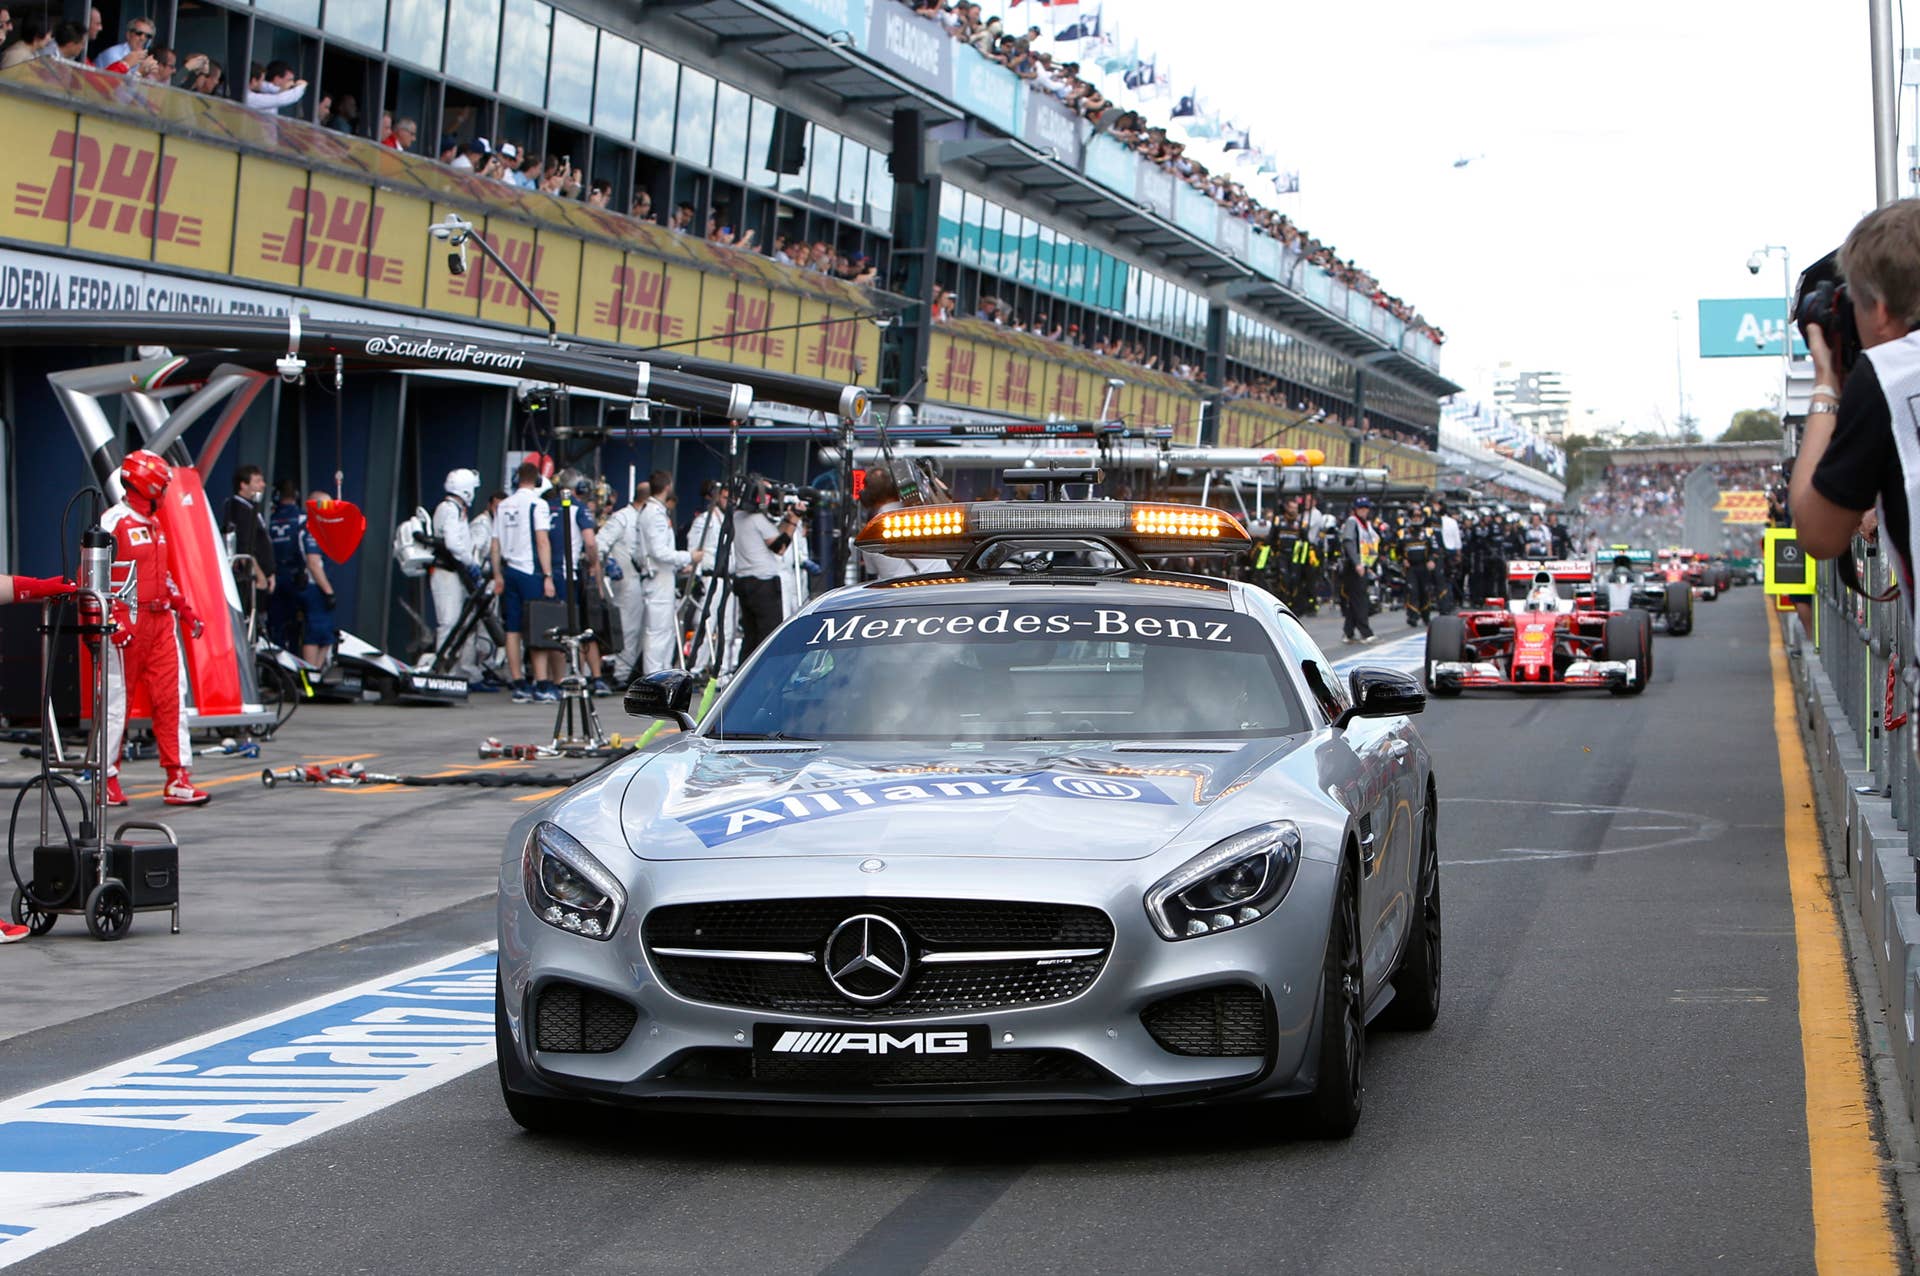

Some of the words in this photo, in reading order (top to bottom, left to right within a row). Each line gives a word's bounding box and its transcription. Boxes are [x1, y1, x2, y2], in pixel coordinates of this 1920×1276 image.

[42, 129, 180, 242] DHL
[281, 186, 386, 282] DHL
[464, 228, 546, 313] DHL
[608, 265, 672, 336] DHL
[365, 335, 525, 370] @ScuderiaFerrari
[723, 292, 776, 356] DHL
[965, 425, 1006, 434] WILLIAMS
[1007, 425, 1044, 433] MARTINI
[1045, 424, 1078, 433] RACING
[806, 609, 1232, 645] Mercedes-Benz
[428, 678, 467, 691] WIHURI
[724, 774, 1042, 837] Allianz
[831, 1032, 968, 1054] AMG
